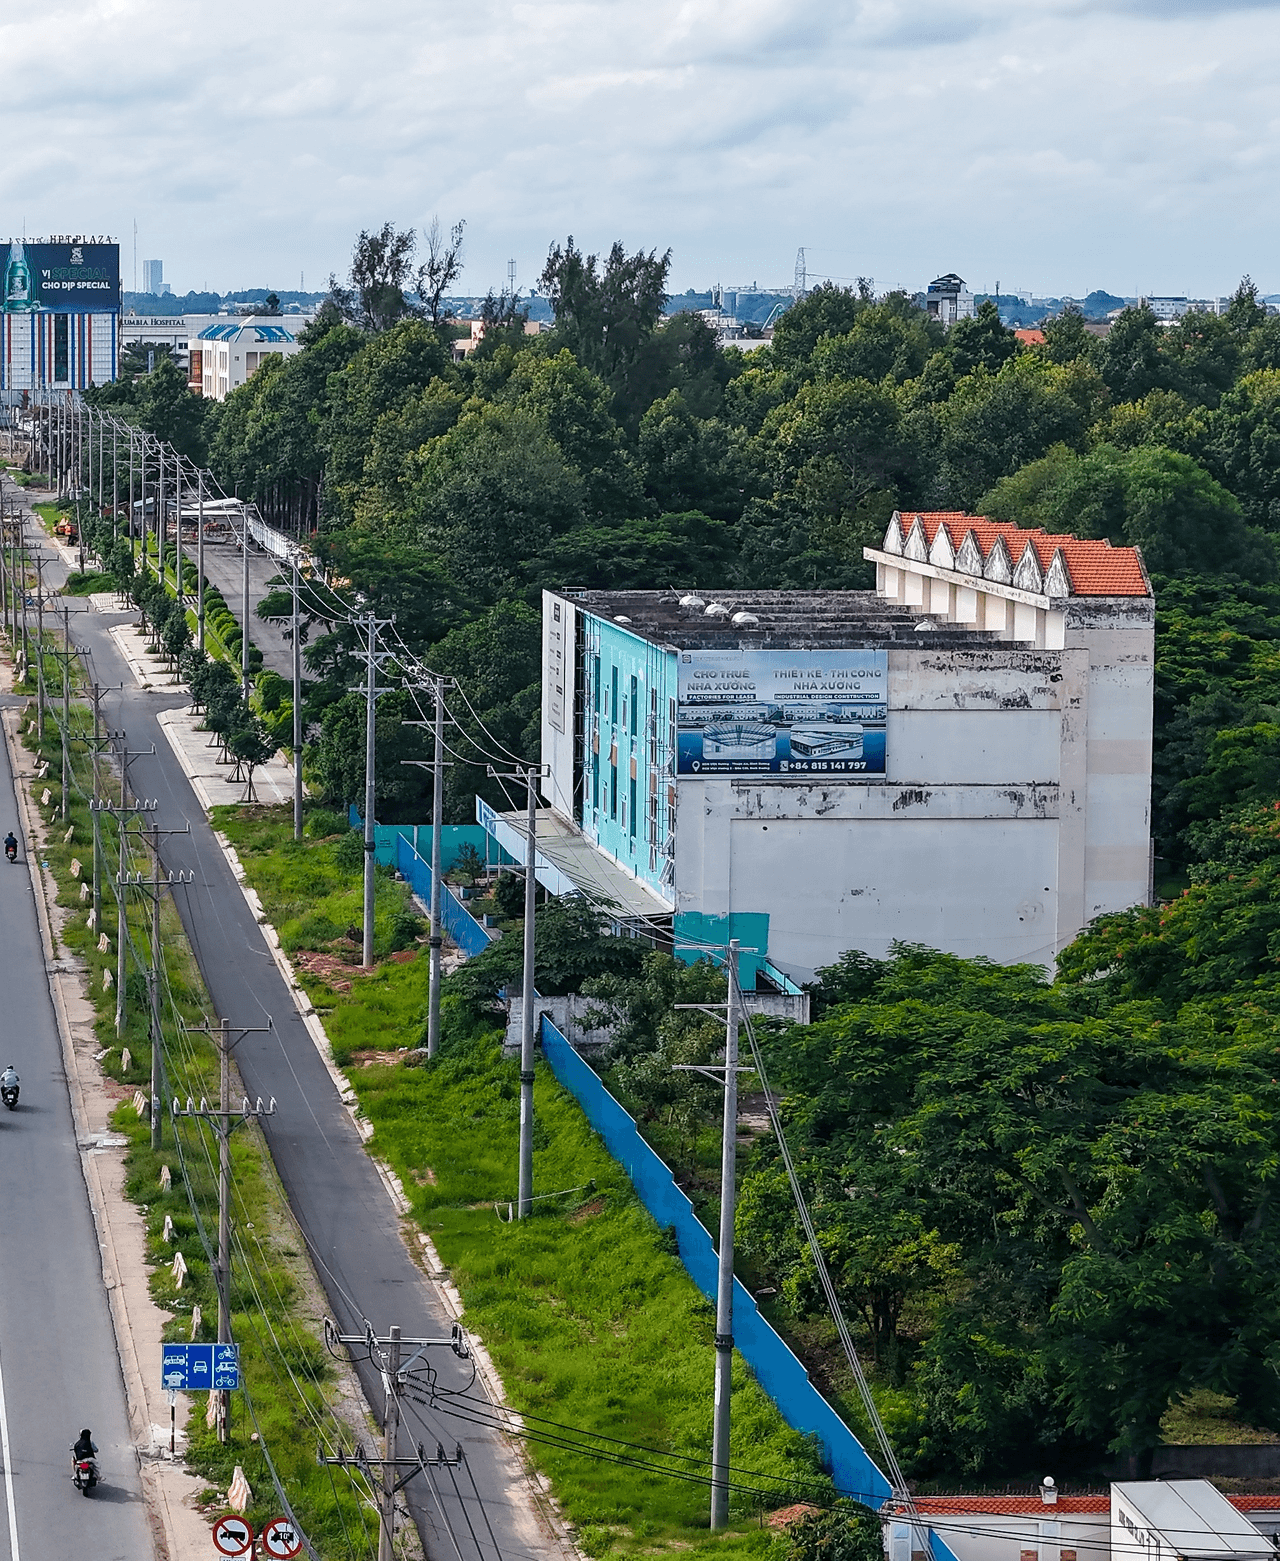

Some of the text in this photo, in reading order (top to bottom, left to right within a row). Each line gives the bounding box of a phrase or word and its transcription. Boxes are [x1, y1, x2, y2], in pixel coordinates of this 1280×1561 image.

[51, 267, 110, 280] SPECIAL
[61, 282, 75, 291] DỊP
[694, 670, 717, 678] CHO
[830, 670, 848, 678] THI
